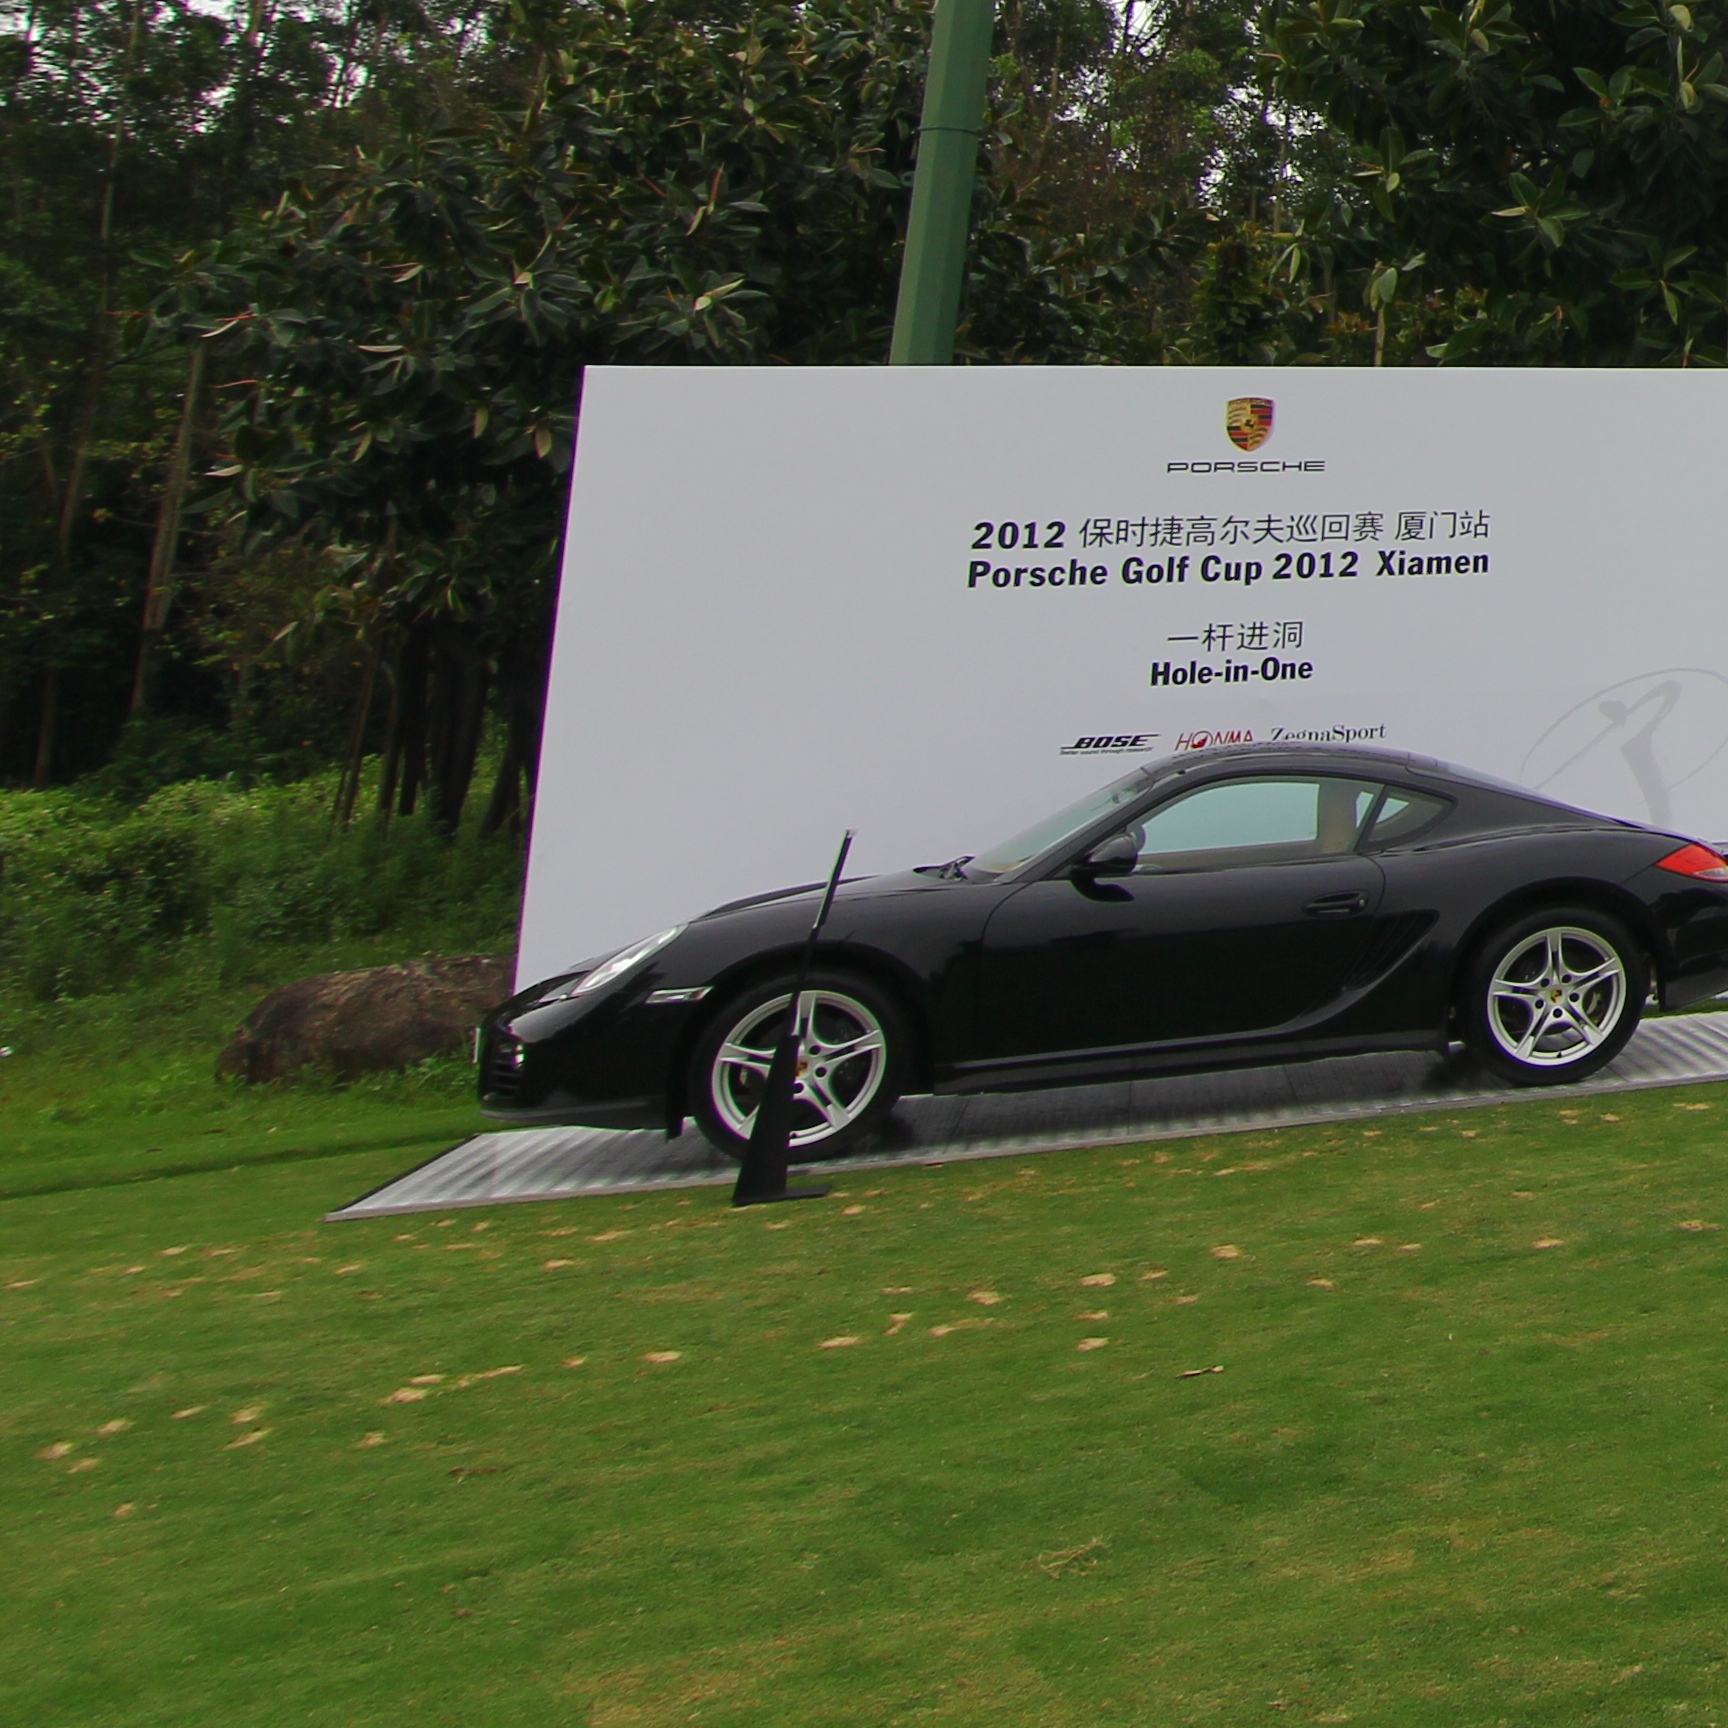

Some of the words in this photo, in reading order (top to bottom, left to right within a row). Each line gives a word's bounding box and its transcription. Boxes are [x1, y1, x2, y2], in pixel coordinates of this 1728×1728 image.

[1166, 460, 1326, 473] PORSCHE
[971, 521, 1066, 550] 2012
[1078, 511, 1385, 549] 保时捷高尔夫巡回赛
[1394, 508, 1491, 541] 厦门站
[967, 559, 1108, 589] Porsche
[1121, 555, 1190, 585] Golf
[1200, 554, 1263, 586] Cup
[1272, 550, 1360, 579] 2012
[1376, 548, 1490, 577] Xiamen
[1166, 620, 1304, 653] 一杆进洞
[1150, 656, 1314, 686] Hole-in-One
[1060, 733, 1160, 749] BOSE
[1175, 729, 1253, 751] HONMA
